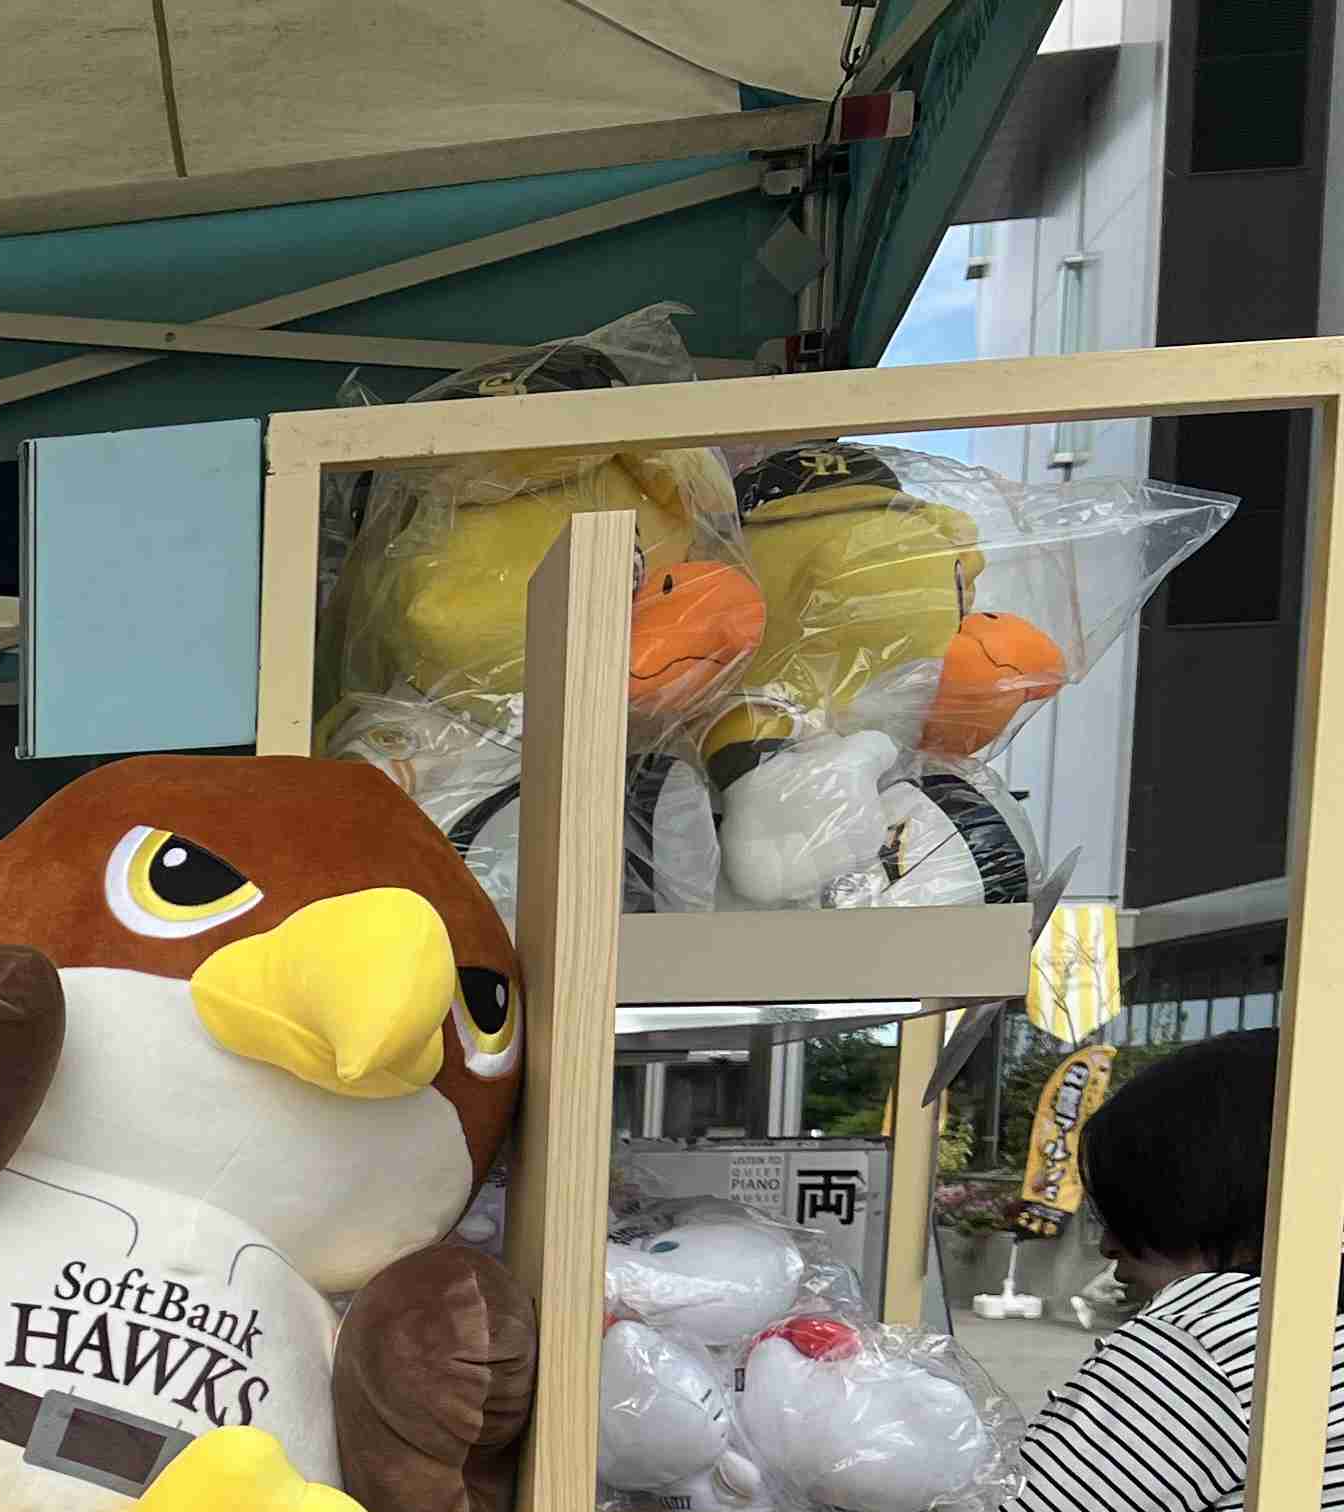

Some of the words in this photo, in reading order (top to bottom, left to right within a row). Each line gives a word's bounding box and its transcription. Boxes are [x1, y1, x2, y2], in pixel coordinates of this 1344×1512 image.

[731, 1178, 781, 1191] PIANO
[53, 1260, 264, 1359] SoftBank
[3, 1301, 270, 1427] HAWKS
